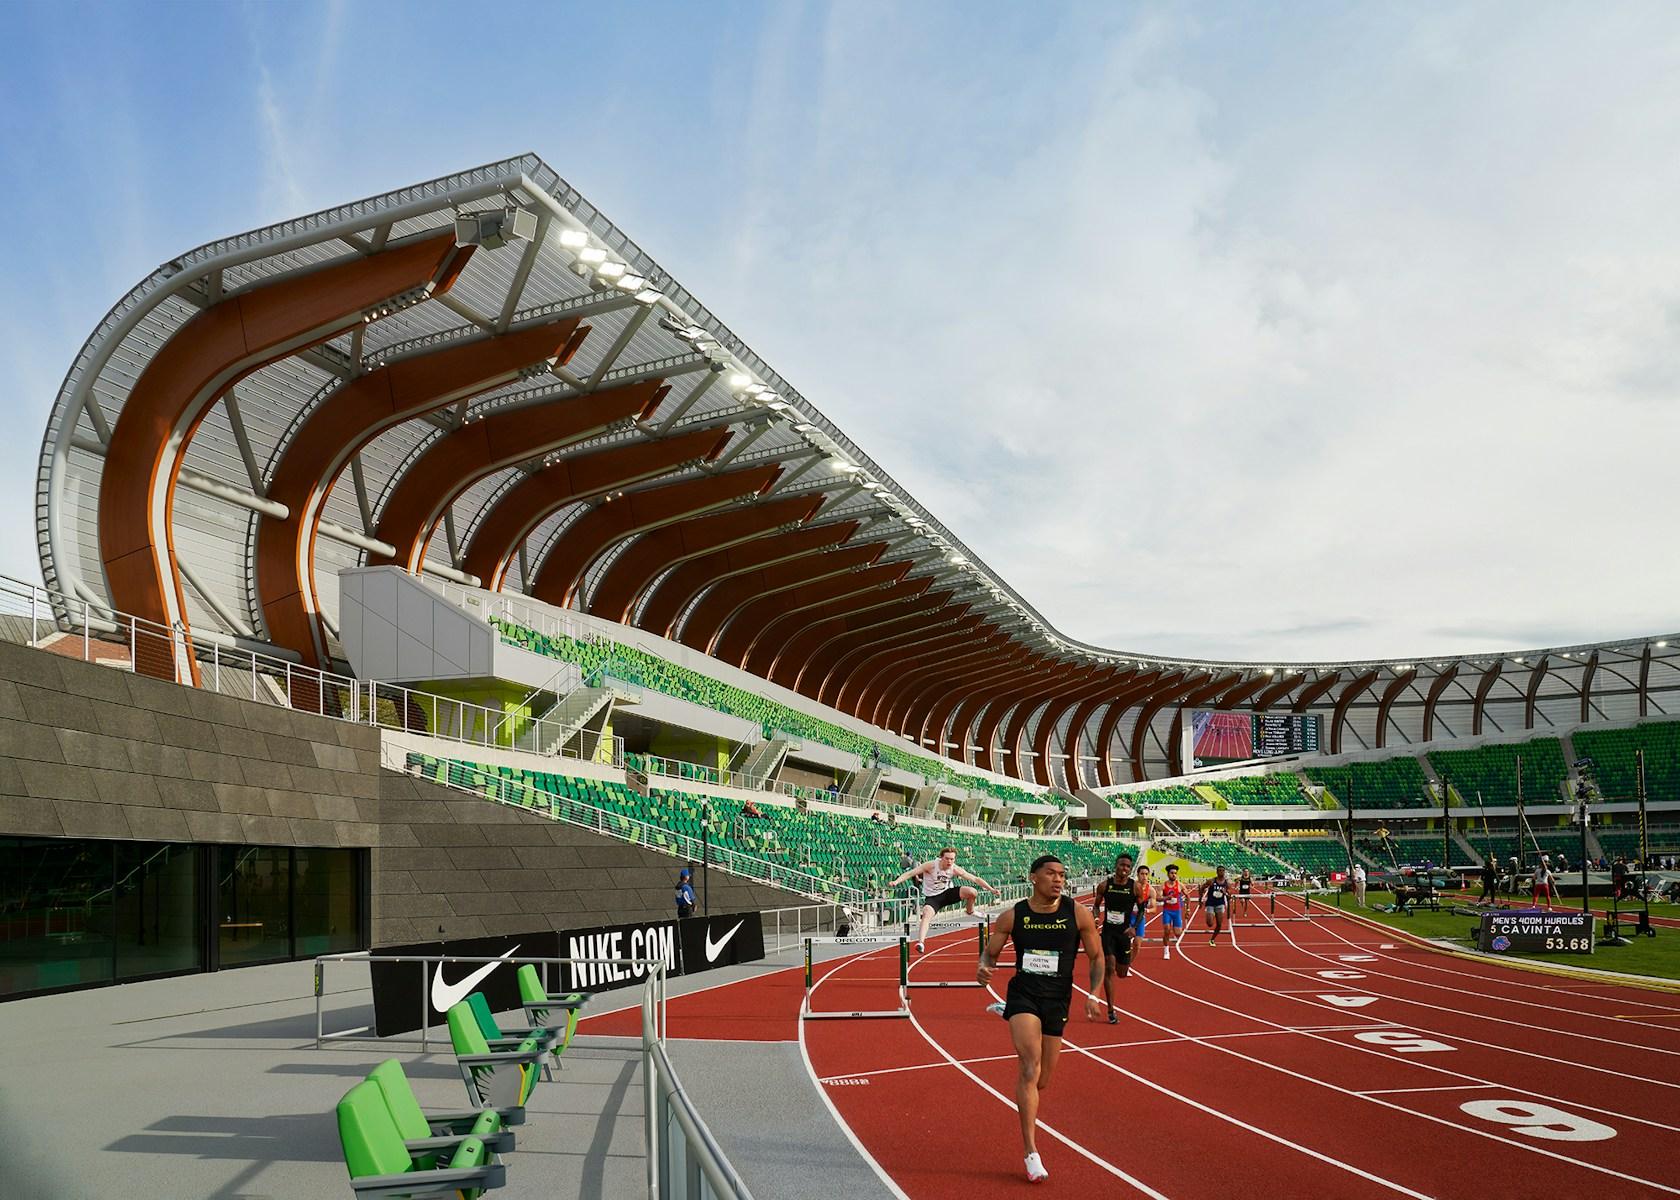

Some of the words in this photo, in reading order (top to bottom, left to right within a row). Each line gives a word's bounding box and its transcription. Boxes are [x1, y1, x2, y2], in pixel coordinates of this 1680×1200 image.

[1493, 917, 1517, 925] MEN'S
[1519, 917, 1542, 925] 400M
[1545, 917, 1584, 925] HURDLES
[1490, 925, 1497, 934] 5
[1501, 925, 1562, 934] CAVINTA
[1545, 938, 1589, 950] 53.68
[569, 925, 675, 989] NIKE.COM
[1353, 1031, 1459, 1053] 5
